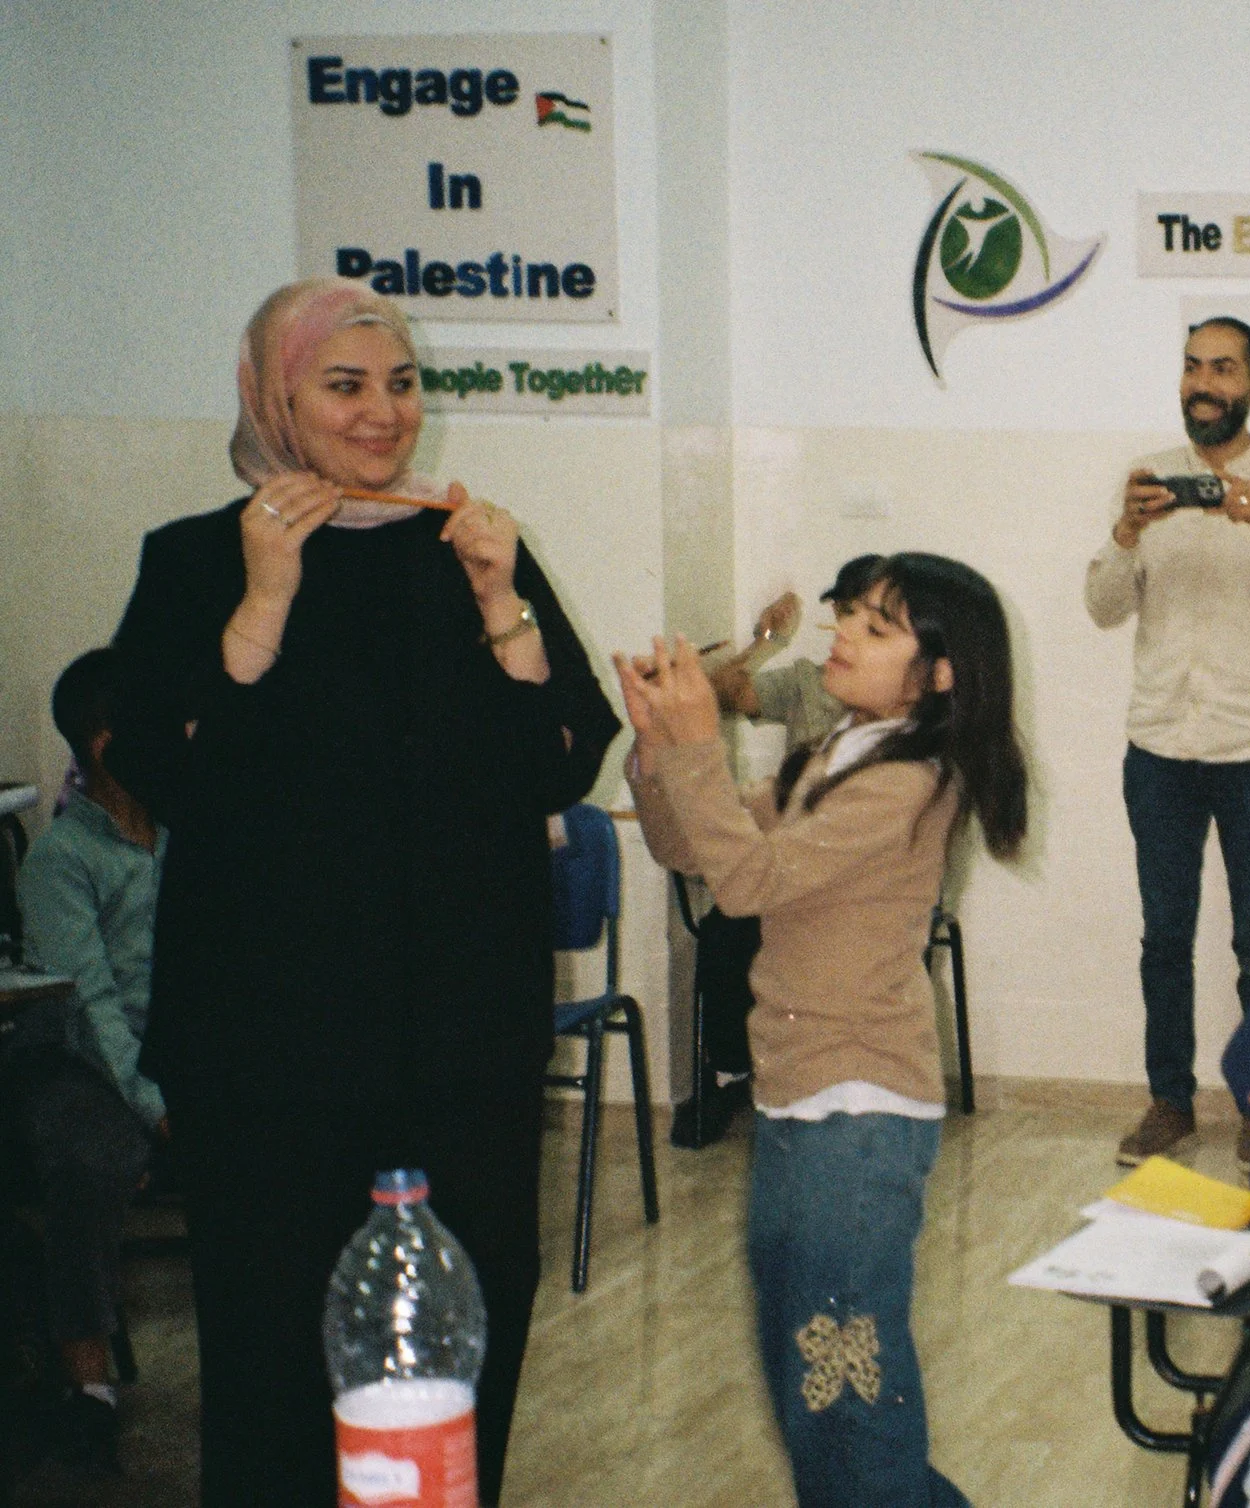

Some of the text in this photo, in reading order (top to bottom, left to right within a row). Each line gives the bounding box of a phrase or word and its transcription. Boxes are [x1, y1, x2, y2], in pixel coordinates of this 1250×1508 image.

[307, 56, 519, 116] Engage
[427, 162, 483, 209] In
[1158, 213, 1221, 251] The
[336, 248, 596, 298] Palestine
[420, 361, 647, 400] eople Together
